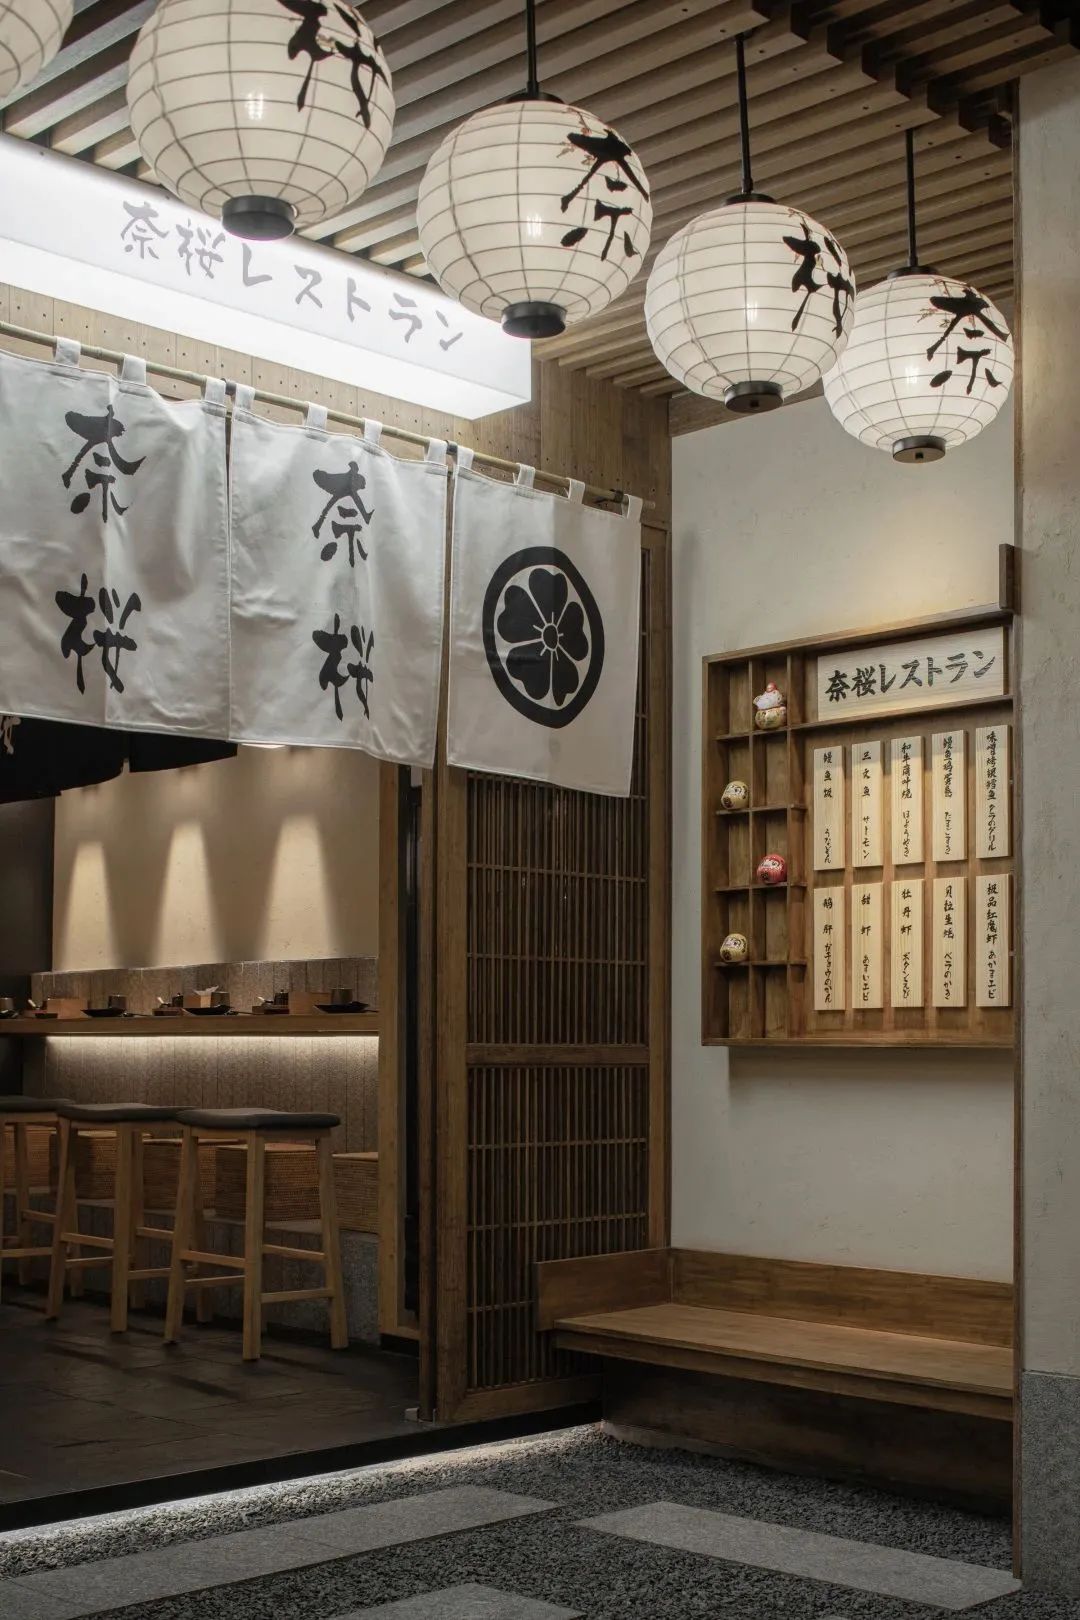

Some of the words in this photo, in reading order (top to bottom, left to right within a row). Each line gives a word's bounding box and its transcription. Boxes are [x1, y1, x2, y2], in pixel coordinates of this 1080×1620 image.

[278, 0, 391, 128] 桜
[561, 126, 652, 262] 奈
[119, 199, 464, 352] 奈桜レストラン
[783, 221, 856, 339] 桜
[926, 288, 1011, 396] 奈
[55, 405, 146, 696] 奈桜
[311, 460, 375, 722] 奈桜
[824, 650, 997, 703] 奈桜レストラン
[861, 750, 872, 797] 三文鱼
[862, 815, 870, 860] サーモン
[822, 897, 834, 935] 鹅肝
[860, 893, 872, 937] 甜虾
[900, 888, 913, 937] 牡丹虾
